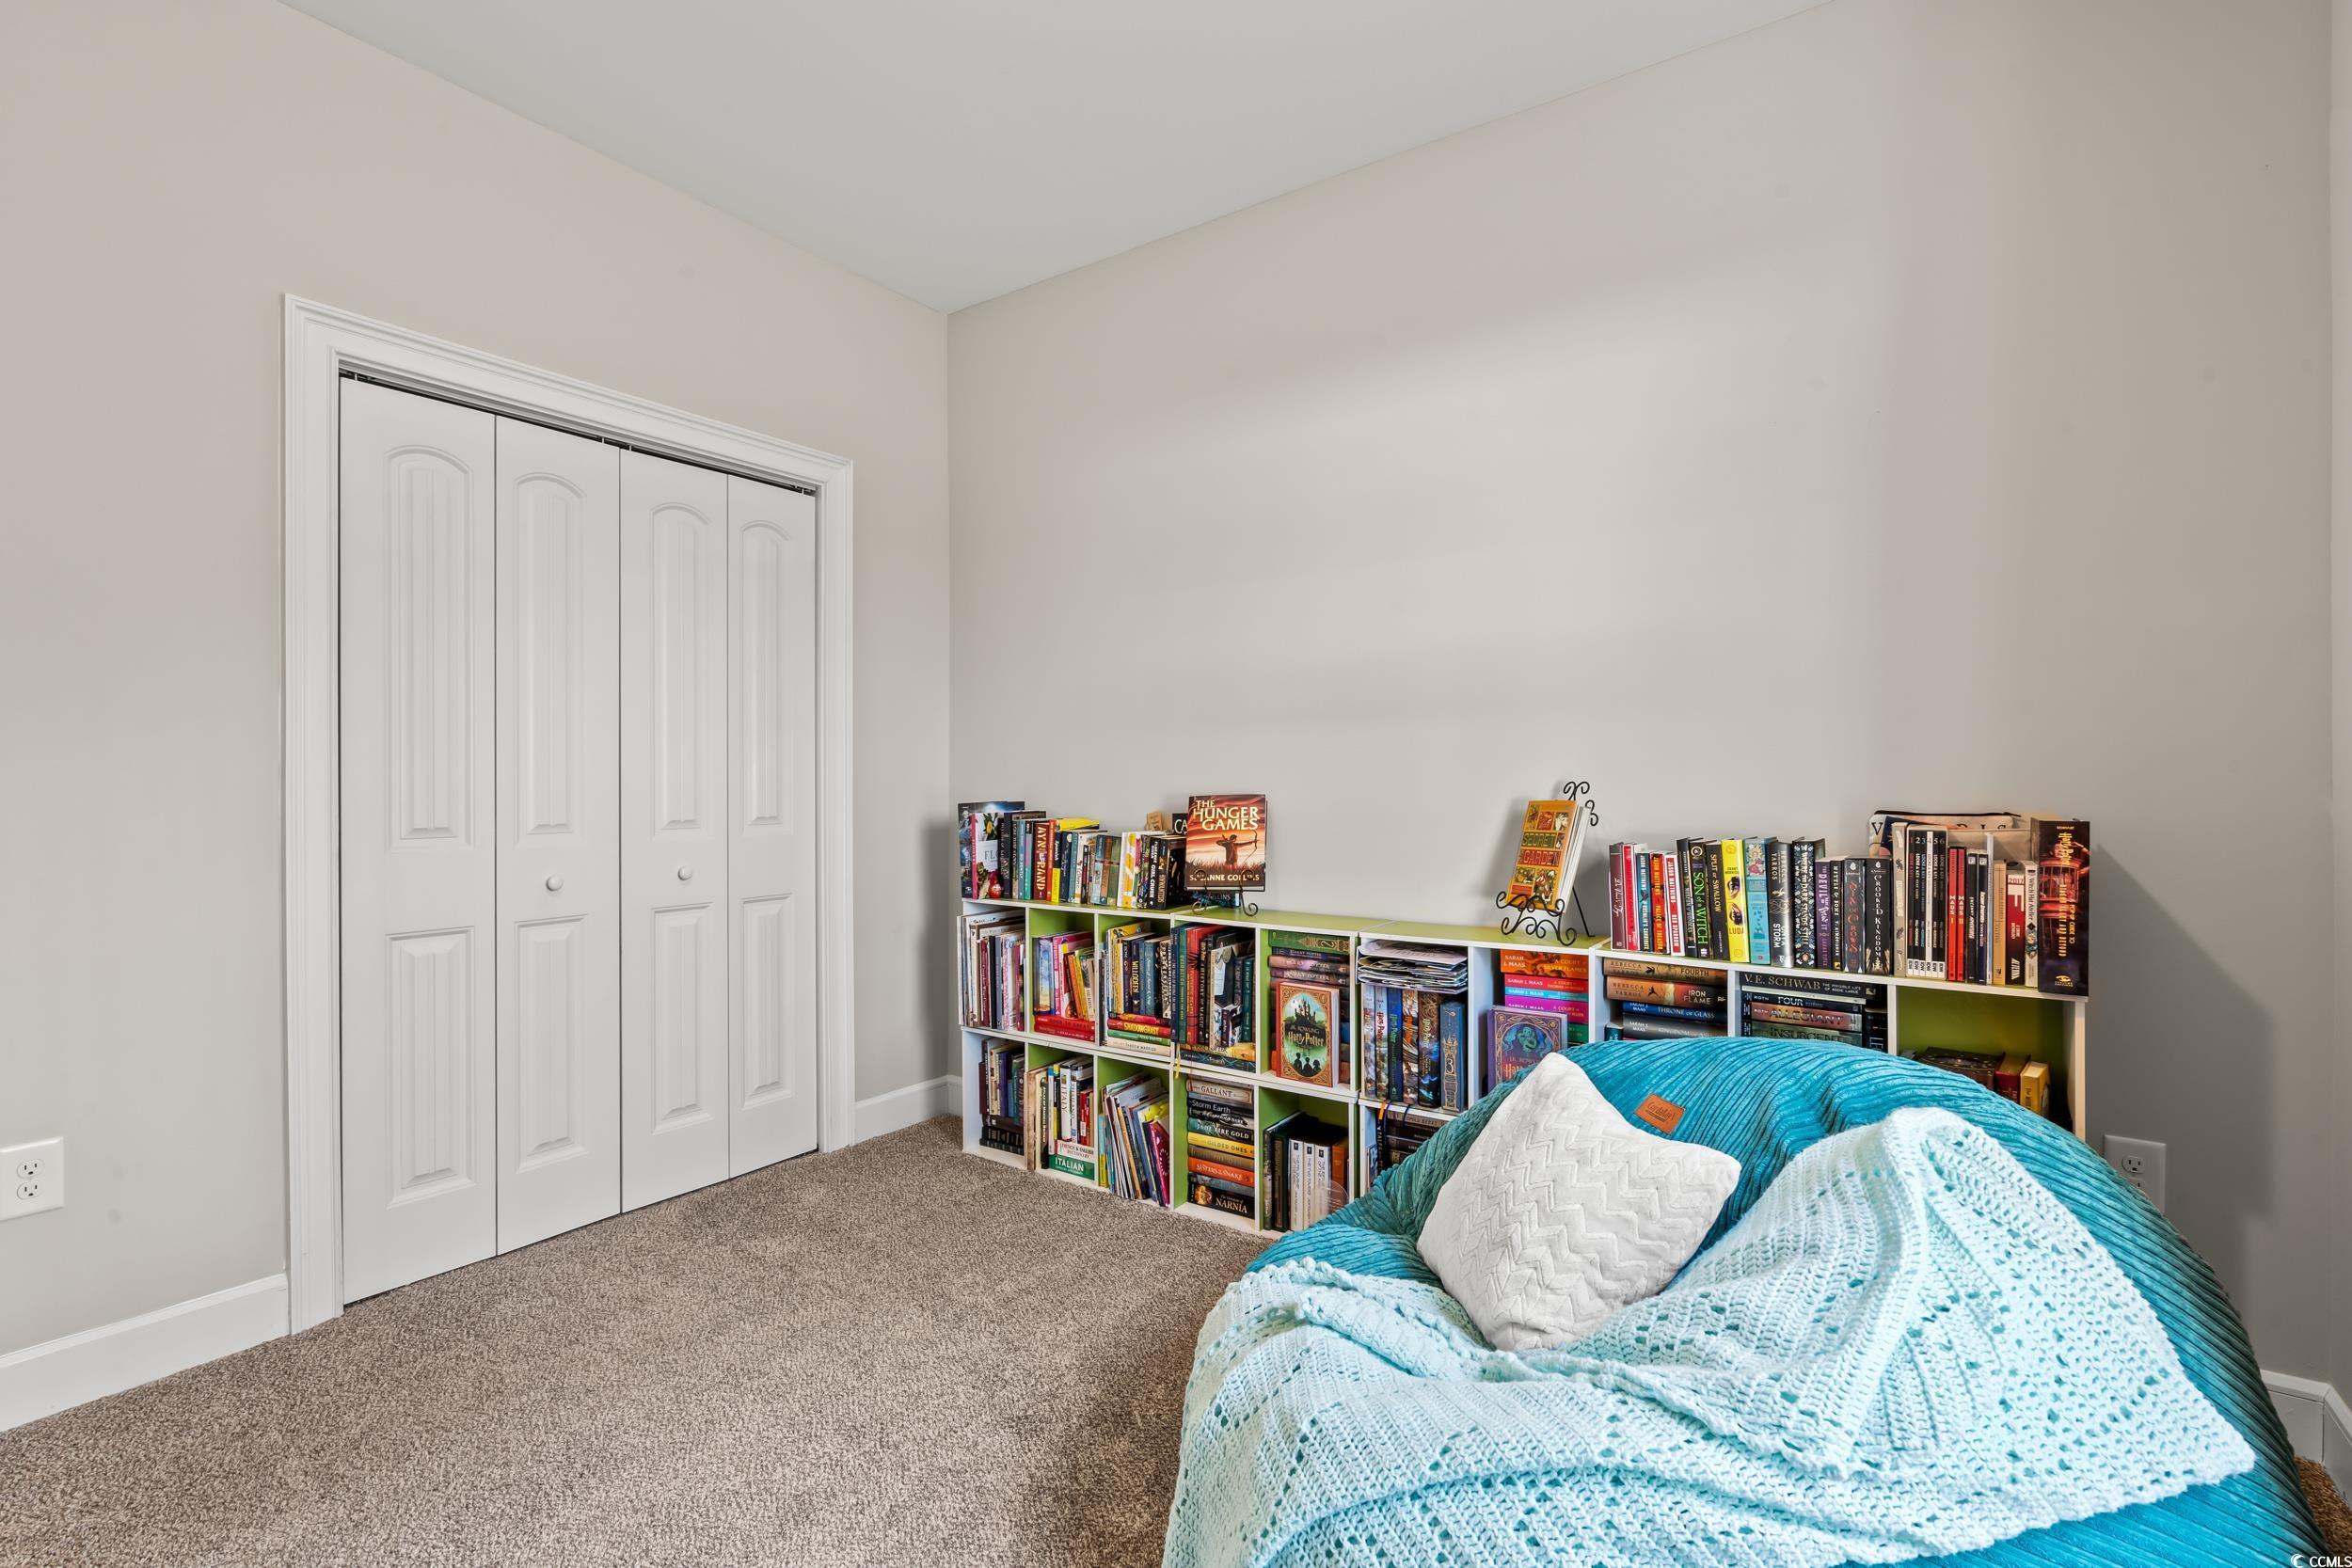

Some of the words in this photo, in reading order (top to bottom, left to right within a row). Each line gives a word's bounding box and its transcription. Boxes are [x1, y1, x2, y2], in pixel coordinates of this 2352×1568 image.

[1196, 800, 1216, 811] THE
[1193, 807, 1260, 822] HUNGER
[1202, 818, 1258, 831] GAMES
[1038, 827, 1046, 847] AYN
[1522, 832, 1556, 846] SECRET
[2058, 832, 2073, 849] Harry
[1523, 850, 1559, 865] GARDEN
[2059, 849, 2074, 865] Potter
[1037, 862, 1046, 890] RAND
[1692, 872, 1705, 895] SON
[1800, 883, 1808, 902] DARK
[1819, 874, 1829, 897] DEVIL
[1712, 880, 1721, 912] SWALLOW
[1874, 875, 1883, 915] CROOKED
[1696, 907, 1708, 944] WITCH
[2058, 925, 2067, 934] AND
[1772, 923, 1781, 948] STORM
[1848, 915, 1859, 954] CROWS
[2058, 937, 2067, 958] BEYOND
[1680, 968, 1709, 977] FOURTH
[2011, 958, 2020, 980] ALTERNA
[1744, 974, 1753, 983] V.
[1756, 975, 1765, 985] E.
[1768, 976, 1821, 990] SCHWAB
[1683, 995, 1711, 1005] FLAME
[1688, 990, 1707, 998] IRON
[1777, 996, 1804, 1006] FOUR
[1658, 1006, 1685, 1016] THRONE
[1693, 1010, 1715, 1019] GLASS
[1769, 1007, 1845, 1025] ALLEGIANT
[1288, 1032, 1305, 1044] Harry
[1306, 1032, 1324, 1047] Potter
[1200, 1085, 1232, 1098] GALLANT
[1192, 1100, 1212, 1109] Storm
[1213, 1104, 1232, 1114] Earth
[1231, 1131, 1249, 1139] GOLD
[1231, 1145, 1248, 1153] ONES
[1056, 1157, 1084, 1171] ITALIAN
[1216, 1197, 1248, 1213] NARNIA
